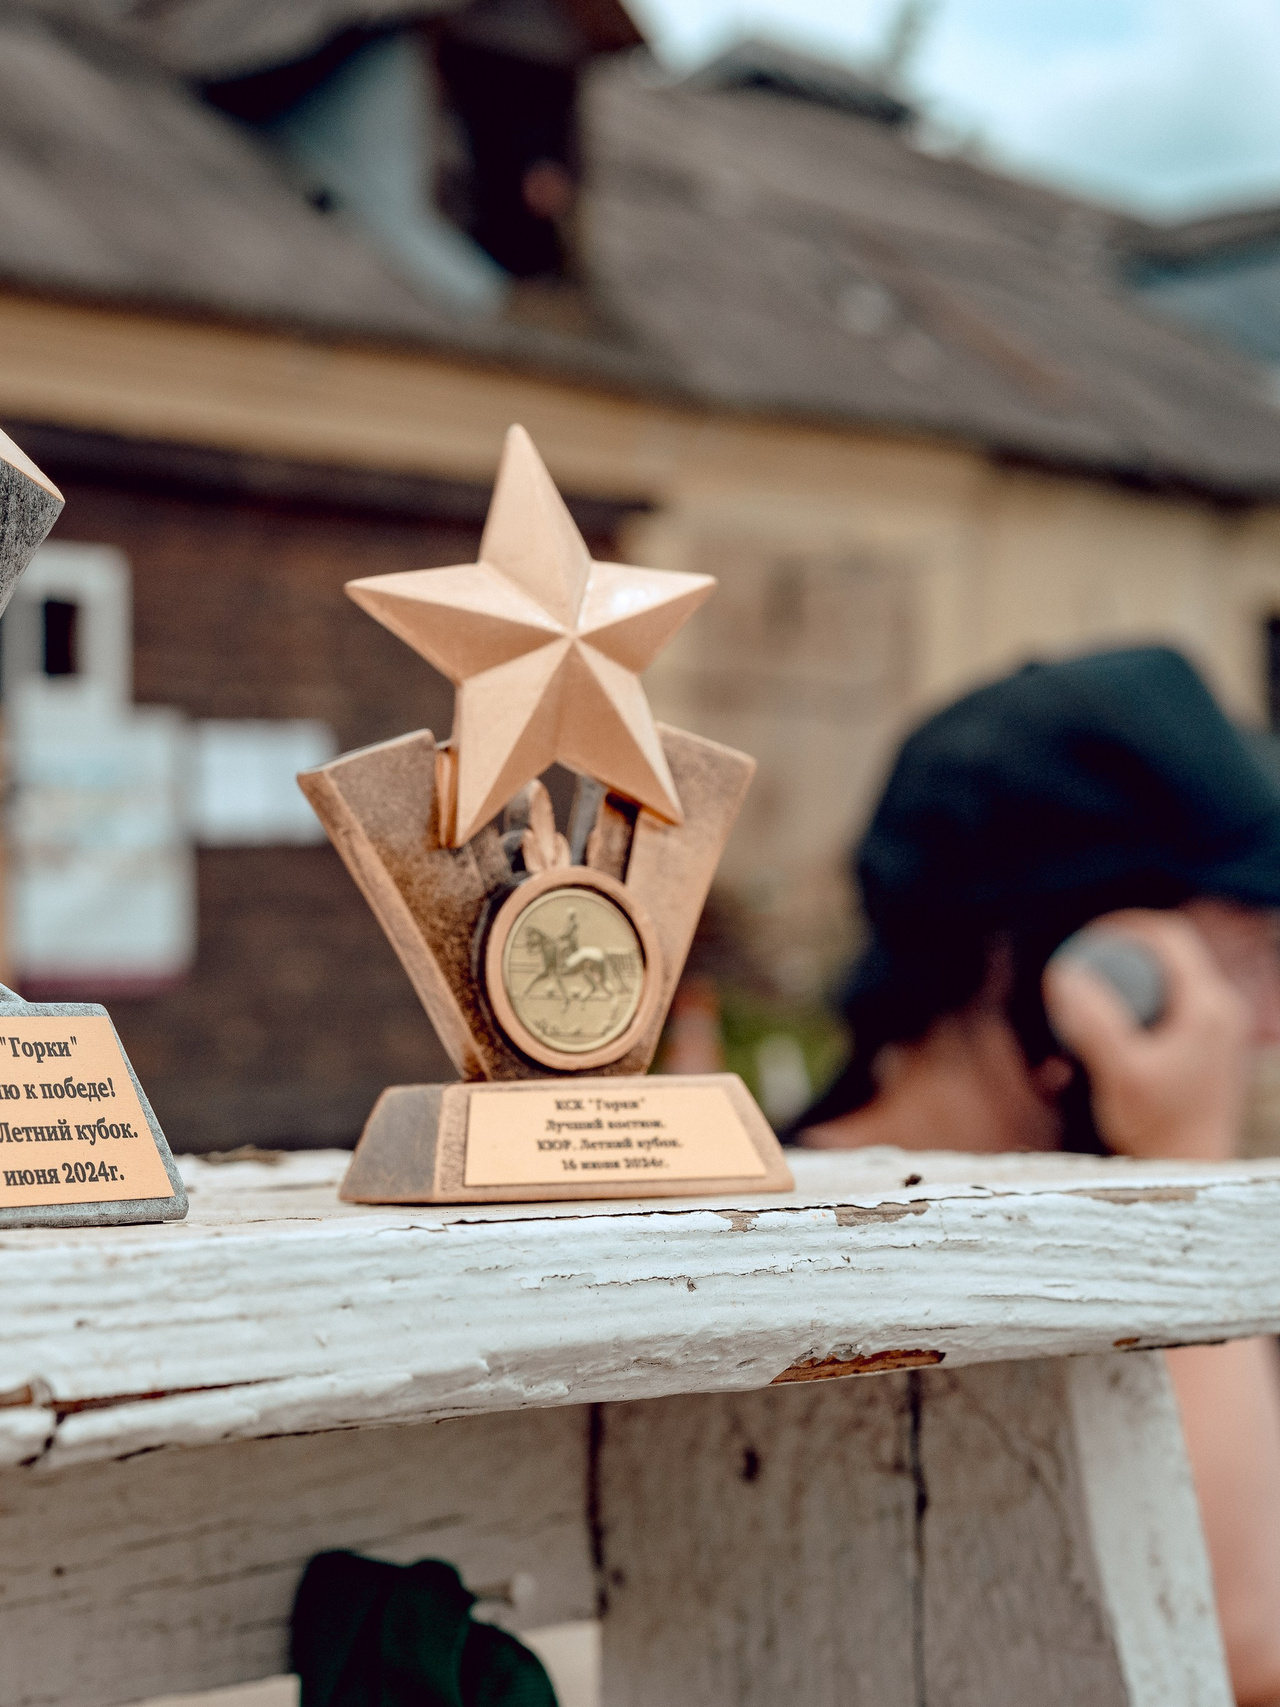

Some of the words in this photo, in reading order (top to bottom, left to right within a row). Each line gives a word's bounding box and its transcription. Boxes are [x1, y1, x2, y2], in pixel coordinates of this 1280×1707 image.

[0, 1036, 77, 1063] "Горки"
[23, 1083, 38, 1099] к
[40, 1077, 116, 1102] победе!
[77, 1118, 138, 1145] кубок.
[3, 1167, 60, 1186] июня
[62, 1161, 124, 1184] 2024г.
